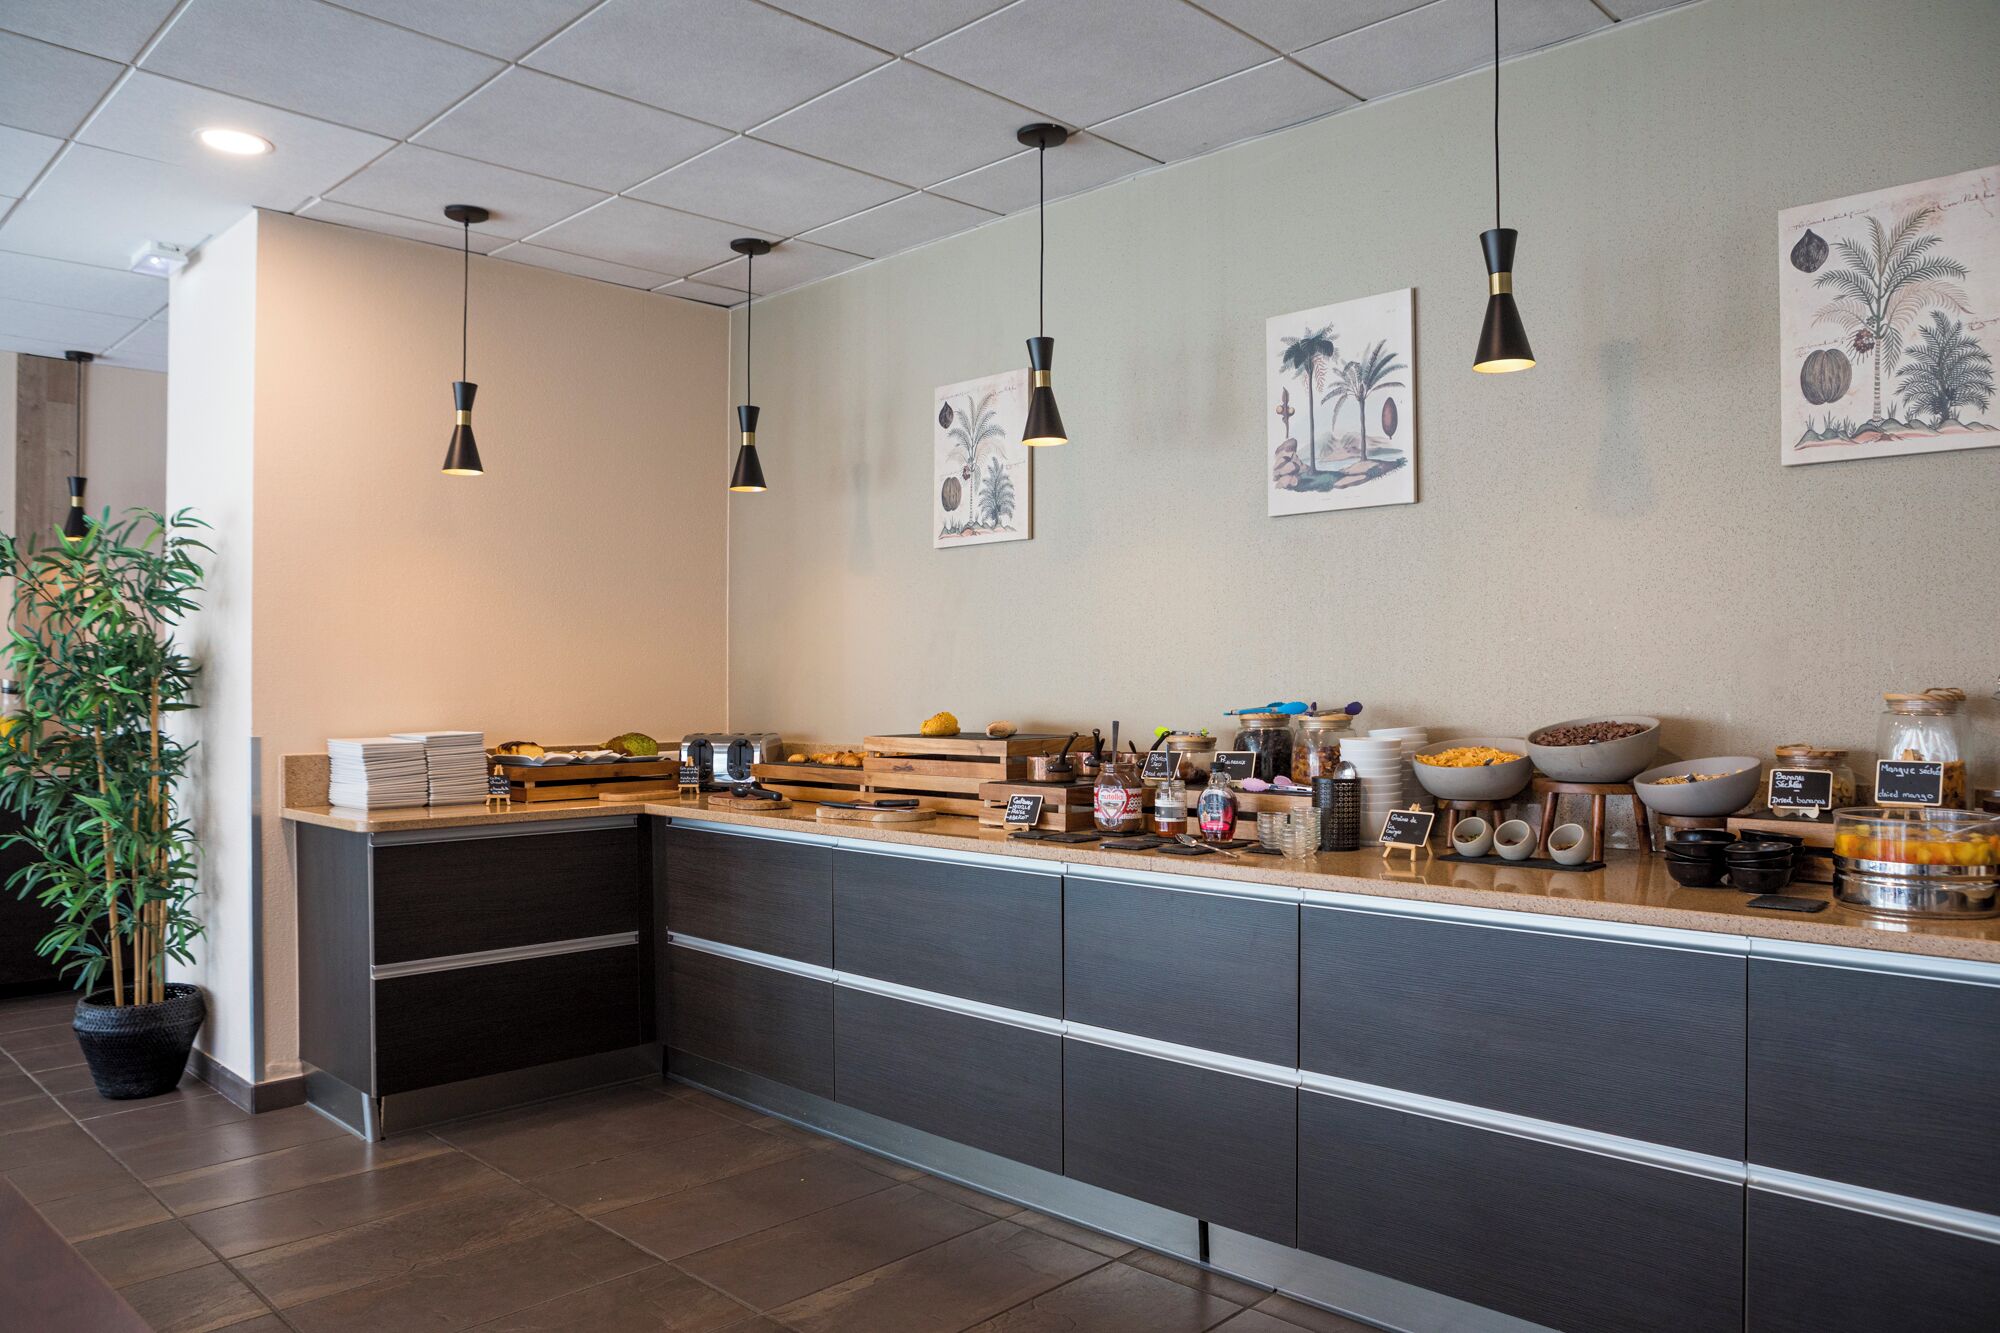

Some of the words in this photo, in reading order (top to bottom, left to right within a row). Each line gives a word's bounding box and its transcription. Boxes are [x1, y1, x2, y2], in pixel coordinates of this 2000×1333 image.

[1881, 764, 1916, 777] Mangue
[1771, 795, 1794, 804] Dried
[1796, 796, 1826, 804] bananas
[1878, 788, 1899, 798] dried
[1902, 792, 1934, 802] mango
